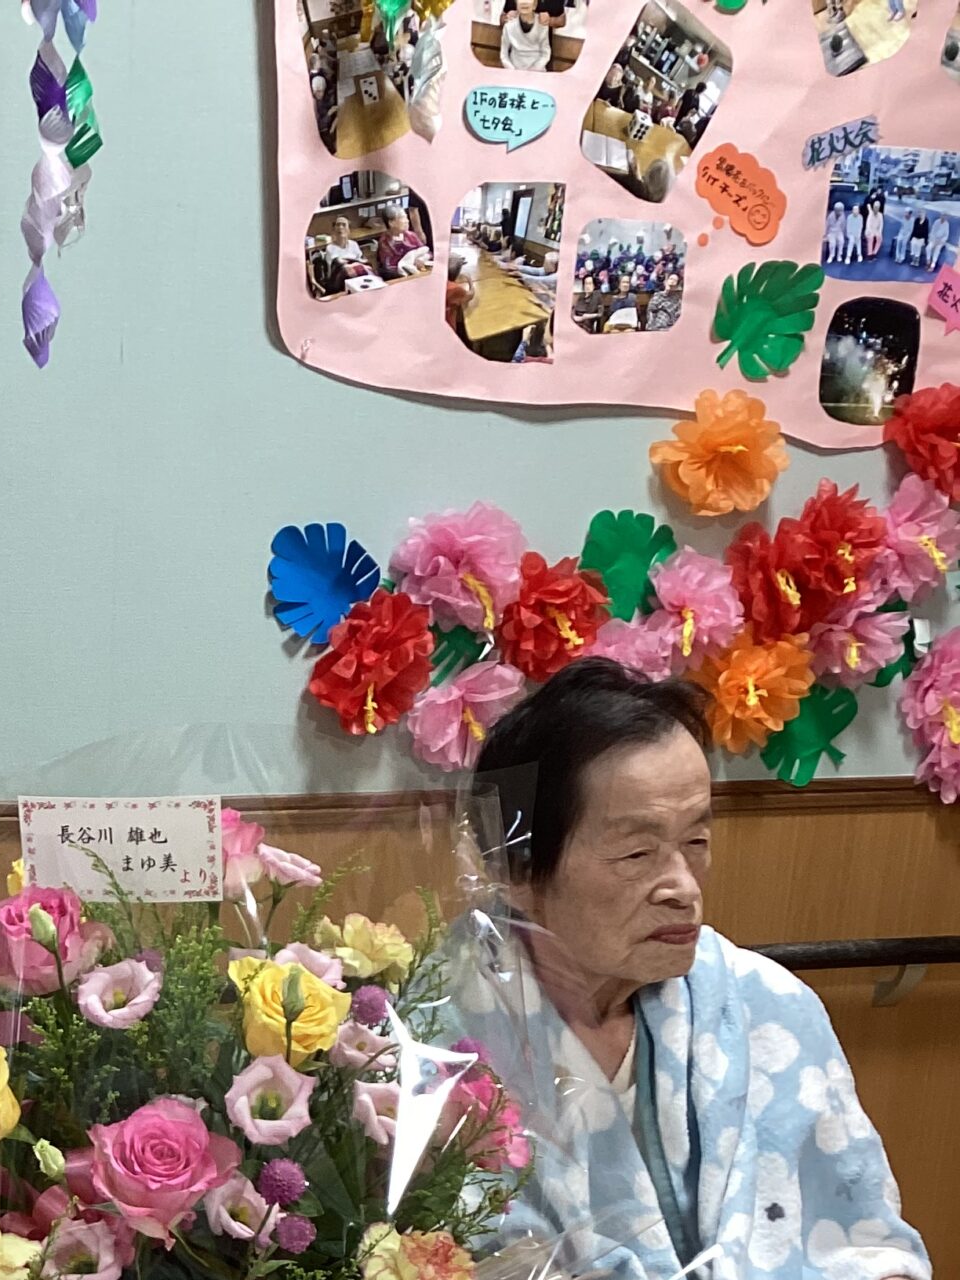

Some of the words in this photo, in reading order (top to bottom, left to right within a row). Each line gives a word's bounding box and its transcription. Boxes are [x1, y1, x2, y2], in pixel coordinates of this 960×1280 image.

[807, 120, 878, 167] 花火大会
[56, 824, 114, 846] 長谷川
[126, 826, 168, 846] 雄也
[121, 852, 178, 873] まゆ美
[179, 867, 207, 885] より
